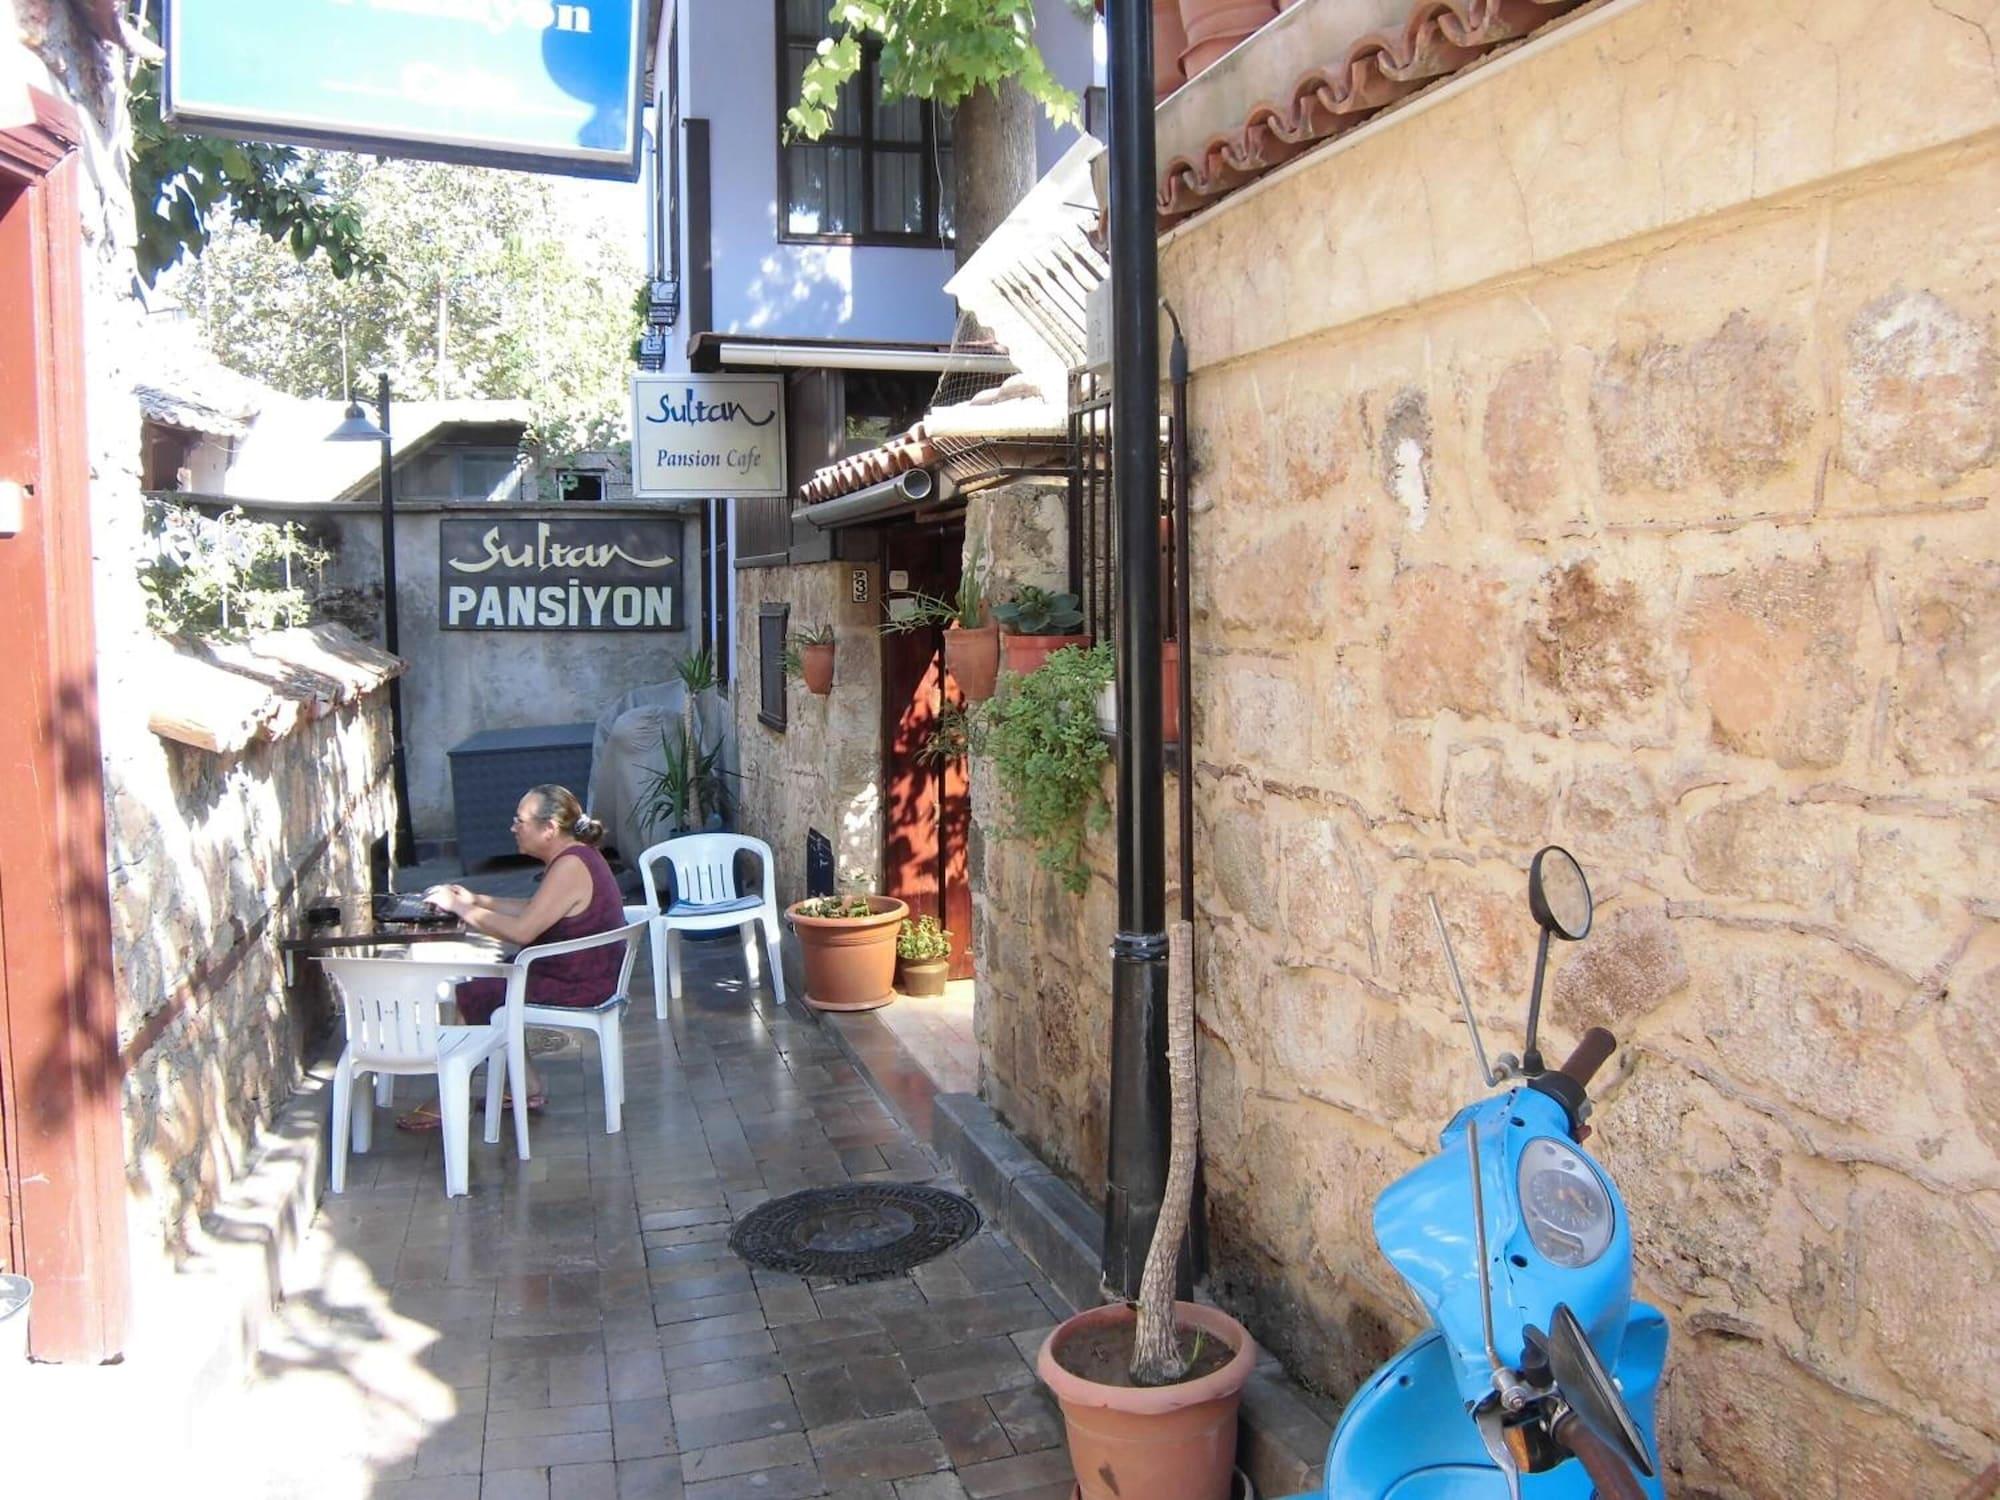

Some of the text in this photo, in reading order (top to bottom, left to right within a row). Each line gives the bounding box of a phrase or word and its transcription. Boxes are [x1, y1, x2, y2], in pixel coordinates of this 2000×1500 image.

[646, 388, 776, 426] Sultan
[656, 445, 762, 475] Pansion Cafe
[448, 521, 675, 573] Sultan
[448, 578, 673, 627] PANSİYON
[856, 579, 866, 593] 3
